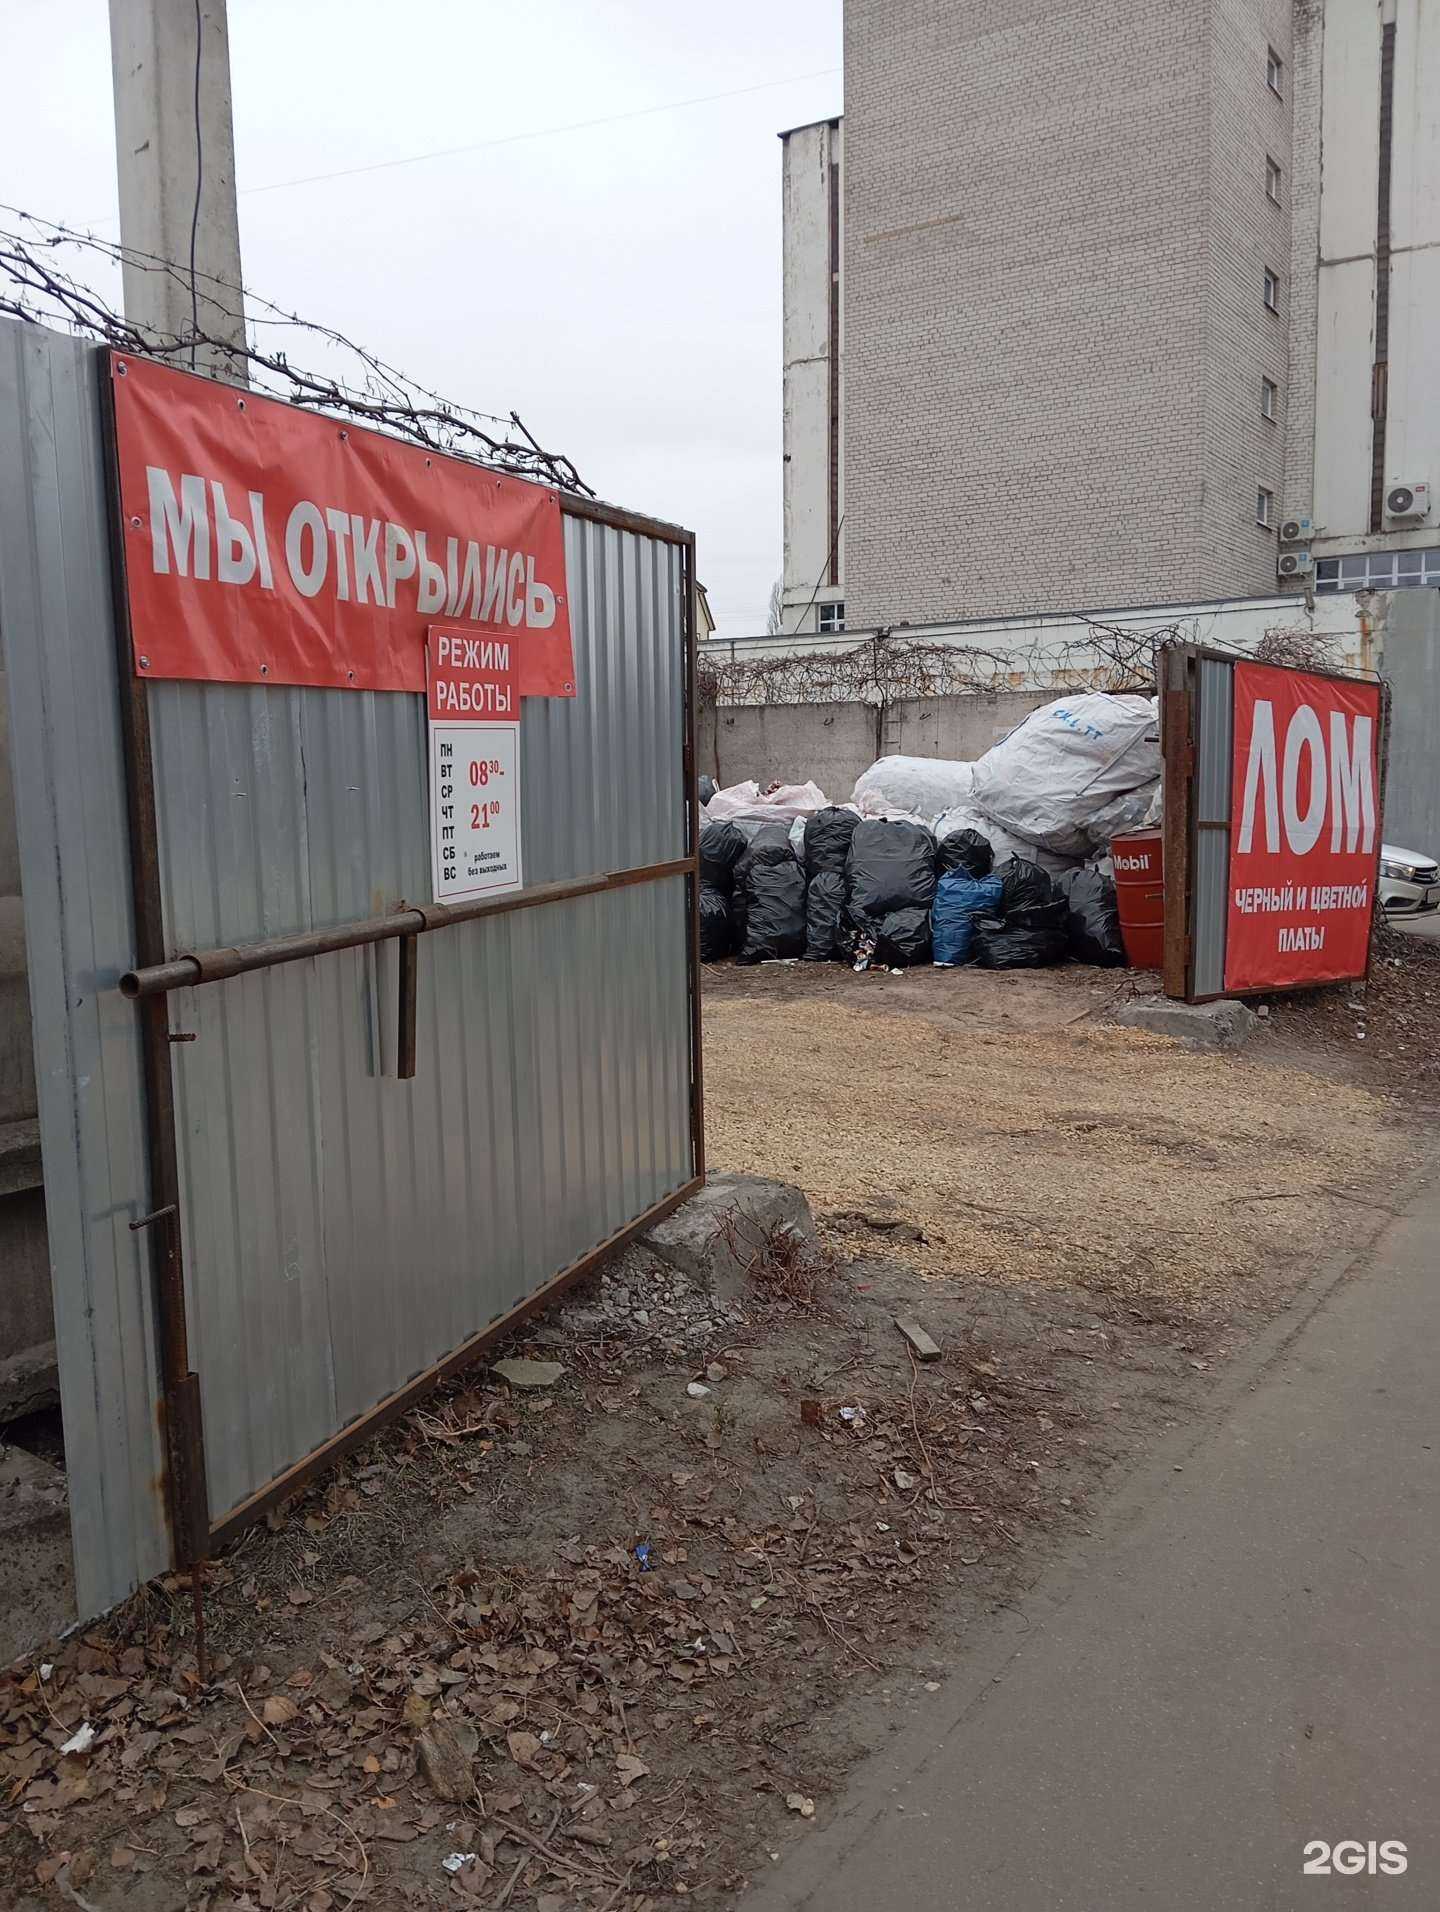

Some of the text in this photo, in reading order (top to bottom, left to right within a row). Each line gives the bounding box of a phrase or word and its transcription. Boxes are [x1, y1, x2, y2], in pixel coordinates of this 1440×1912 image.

[146, 466, 557, 629] МЫ ОТКРЫЛИСЬ
[438, 636, 509, 671] РЕЖИМ
[436, 680, 511, 711] РАБОТЫ
[440, 743, 453, 757] ПН
[441, 764, 452, 778] ВТ
[1237, 699, 1376, 856] ЛОМ
[441, 784, 453, 799] СР
[441, 805, 454, 819] ЧТ
[442, 826, 455, 840] ПТ
[442, 846, 456, 860] СБ
[474, 851, 500, 864] работаем
[1113, 854, 1149, 870] Mobil
[443, 866, 457, 881] ВС
[468, 866, 478, 876] без
[1235, 877, 1367, 914] ЧЕРНЫЙ И ЦВЕТНОЙ
[1278, 926, 1325, 952] ПЛАТЫ
